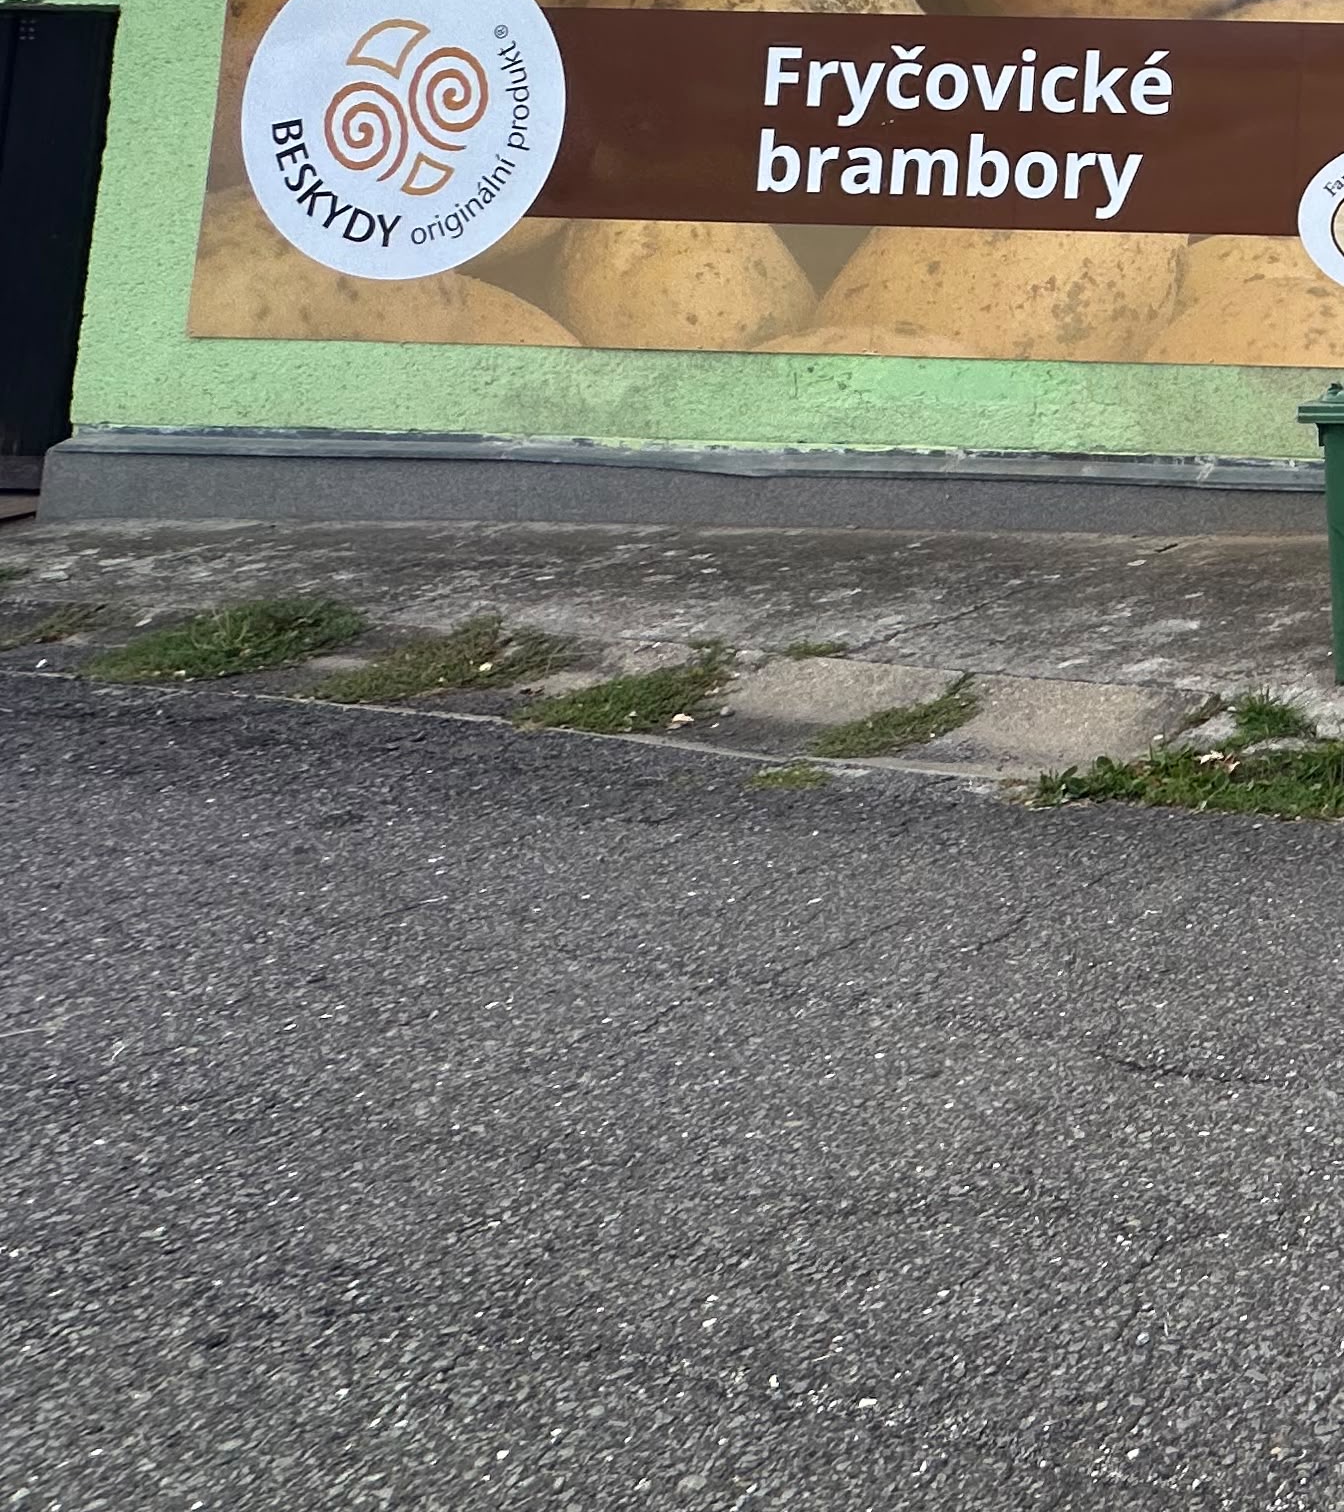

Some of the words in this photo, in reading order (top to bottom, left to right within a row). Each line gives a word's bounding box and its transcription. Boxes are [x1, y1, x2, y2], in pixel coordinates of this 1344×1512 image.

[763, 44, 1174, 127] Fryčovické
[272, 118, 402, 247] BESKYDY
[410, 157, 516, 246] originální
[498, 40, 531, 151] produkt
[756, 128, 1144, 220] brambory
